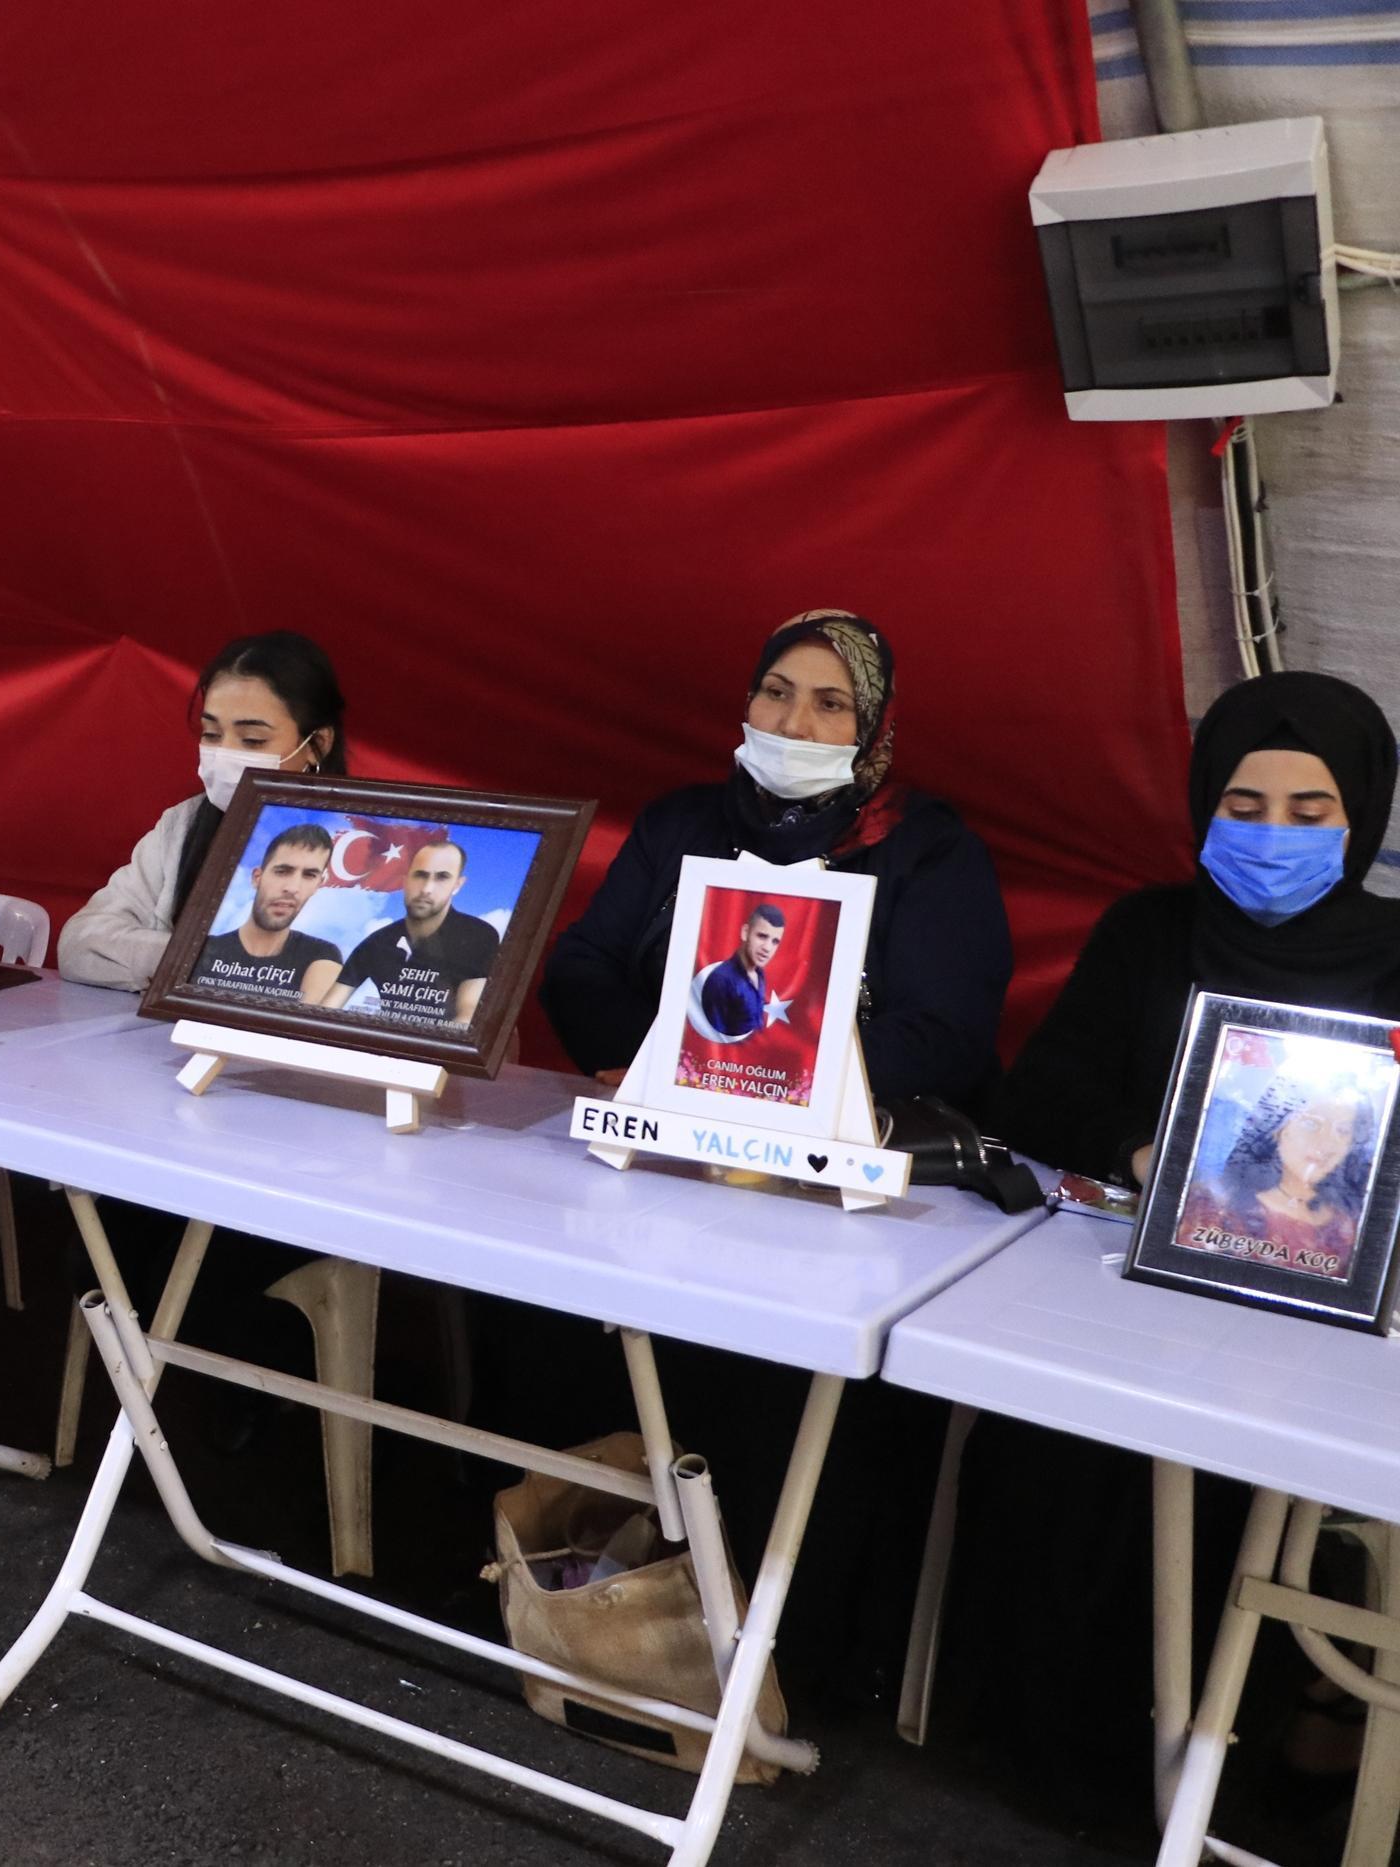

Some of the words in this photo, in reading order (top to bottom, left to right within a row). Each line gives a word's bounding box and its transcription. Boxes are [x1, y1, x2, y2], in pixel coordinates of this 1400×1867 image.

[211, 958, 256, 978] Rojhat
[256, 964, 297, 986] ÇİFÇİ
[399, 966, 440, 983] ŞEHİT
[216, 978, 264, 994] TARAFINDAN
[380, 981, 415, 1001] SAMİ
[414, 985, 451, 1004] ÇİFÇİ
[392, 1000, 446, 1016] TARAFINDAN
[744, 1064, 787, 1081] OĞLUM
[701, 1072, 736, 1090] EREN
[739, 1078, 789, 1099] YALÇIN
[582, 1107, 660, 1142] EREN
[692, 1129, 794, 1168] YALÇIN
[1192, 1226, 1290, 1260] ZÜBEYDA
[1294, 1249, 1339, 1272] KOÇ
